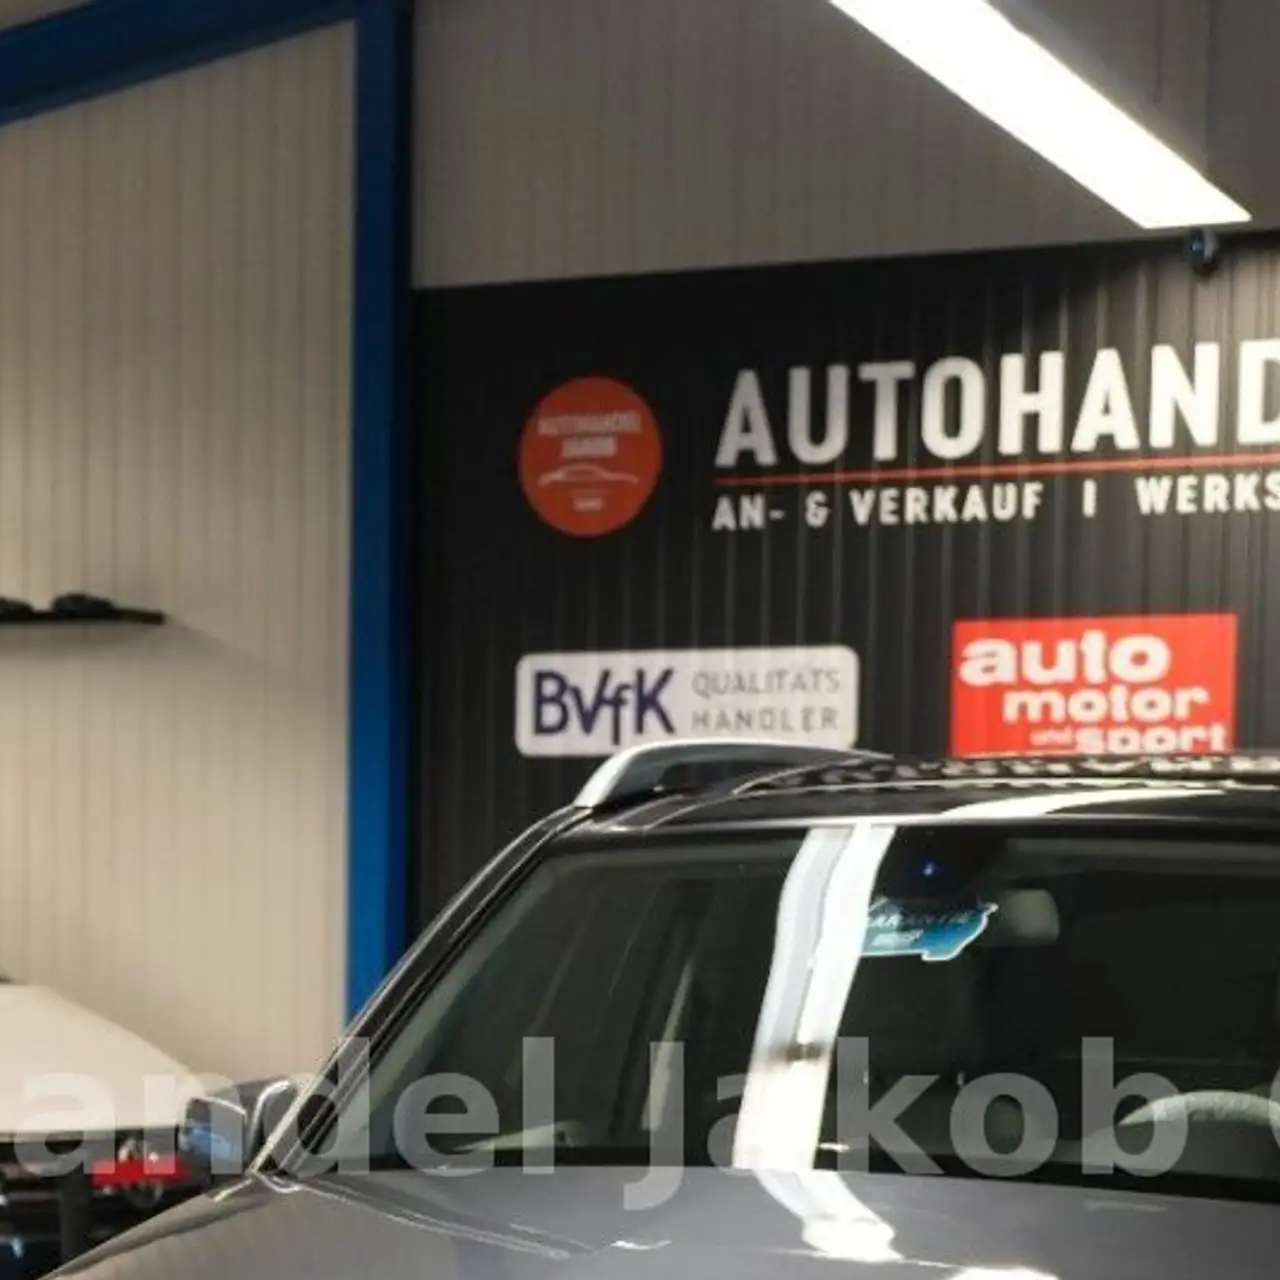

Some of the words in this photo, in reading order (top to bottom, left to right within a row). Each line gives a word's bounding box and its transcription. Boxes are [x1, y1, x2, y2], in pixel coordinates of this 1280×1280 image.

[713, 493, 785, 531] AN-
[805, 489, 830, 528] &
[850, 481, 1044, 526] VERKAUF
[958, 629, 1172, 686] auto
[532, 667, 677, 746] BVfK
[1002, 684, 1210, 723] motor
[1074, 721, 1228, 753] sport
